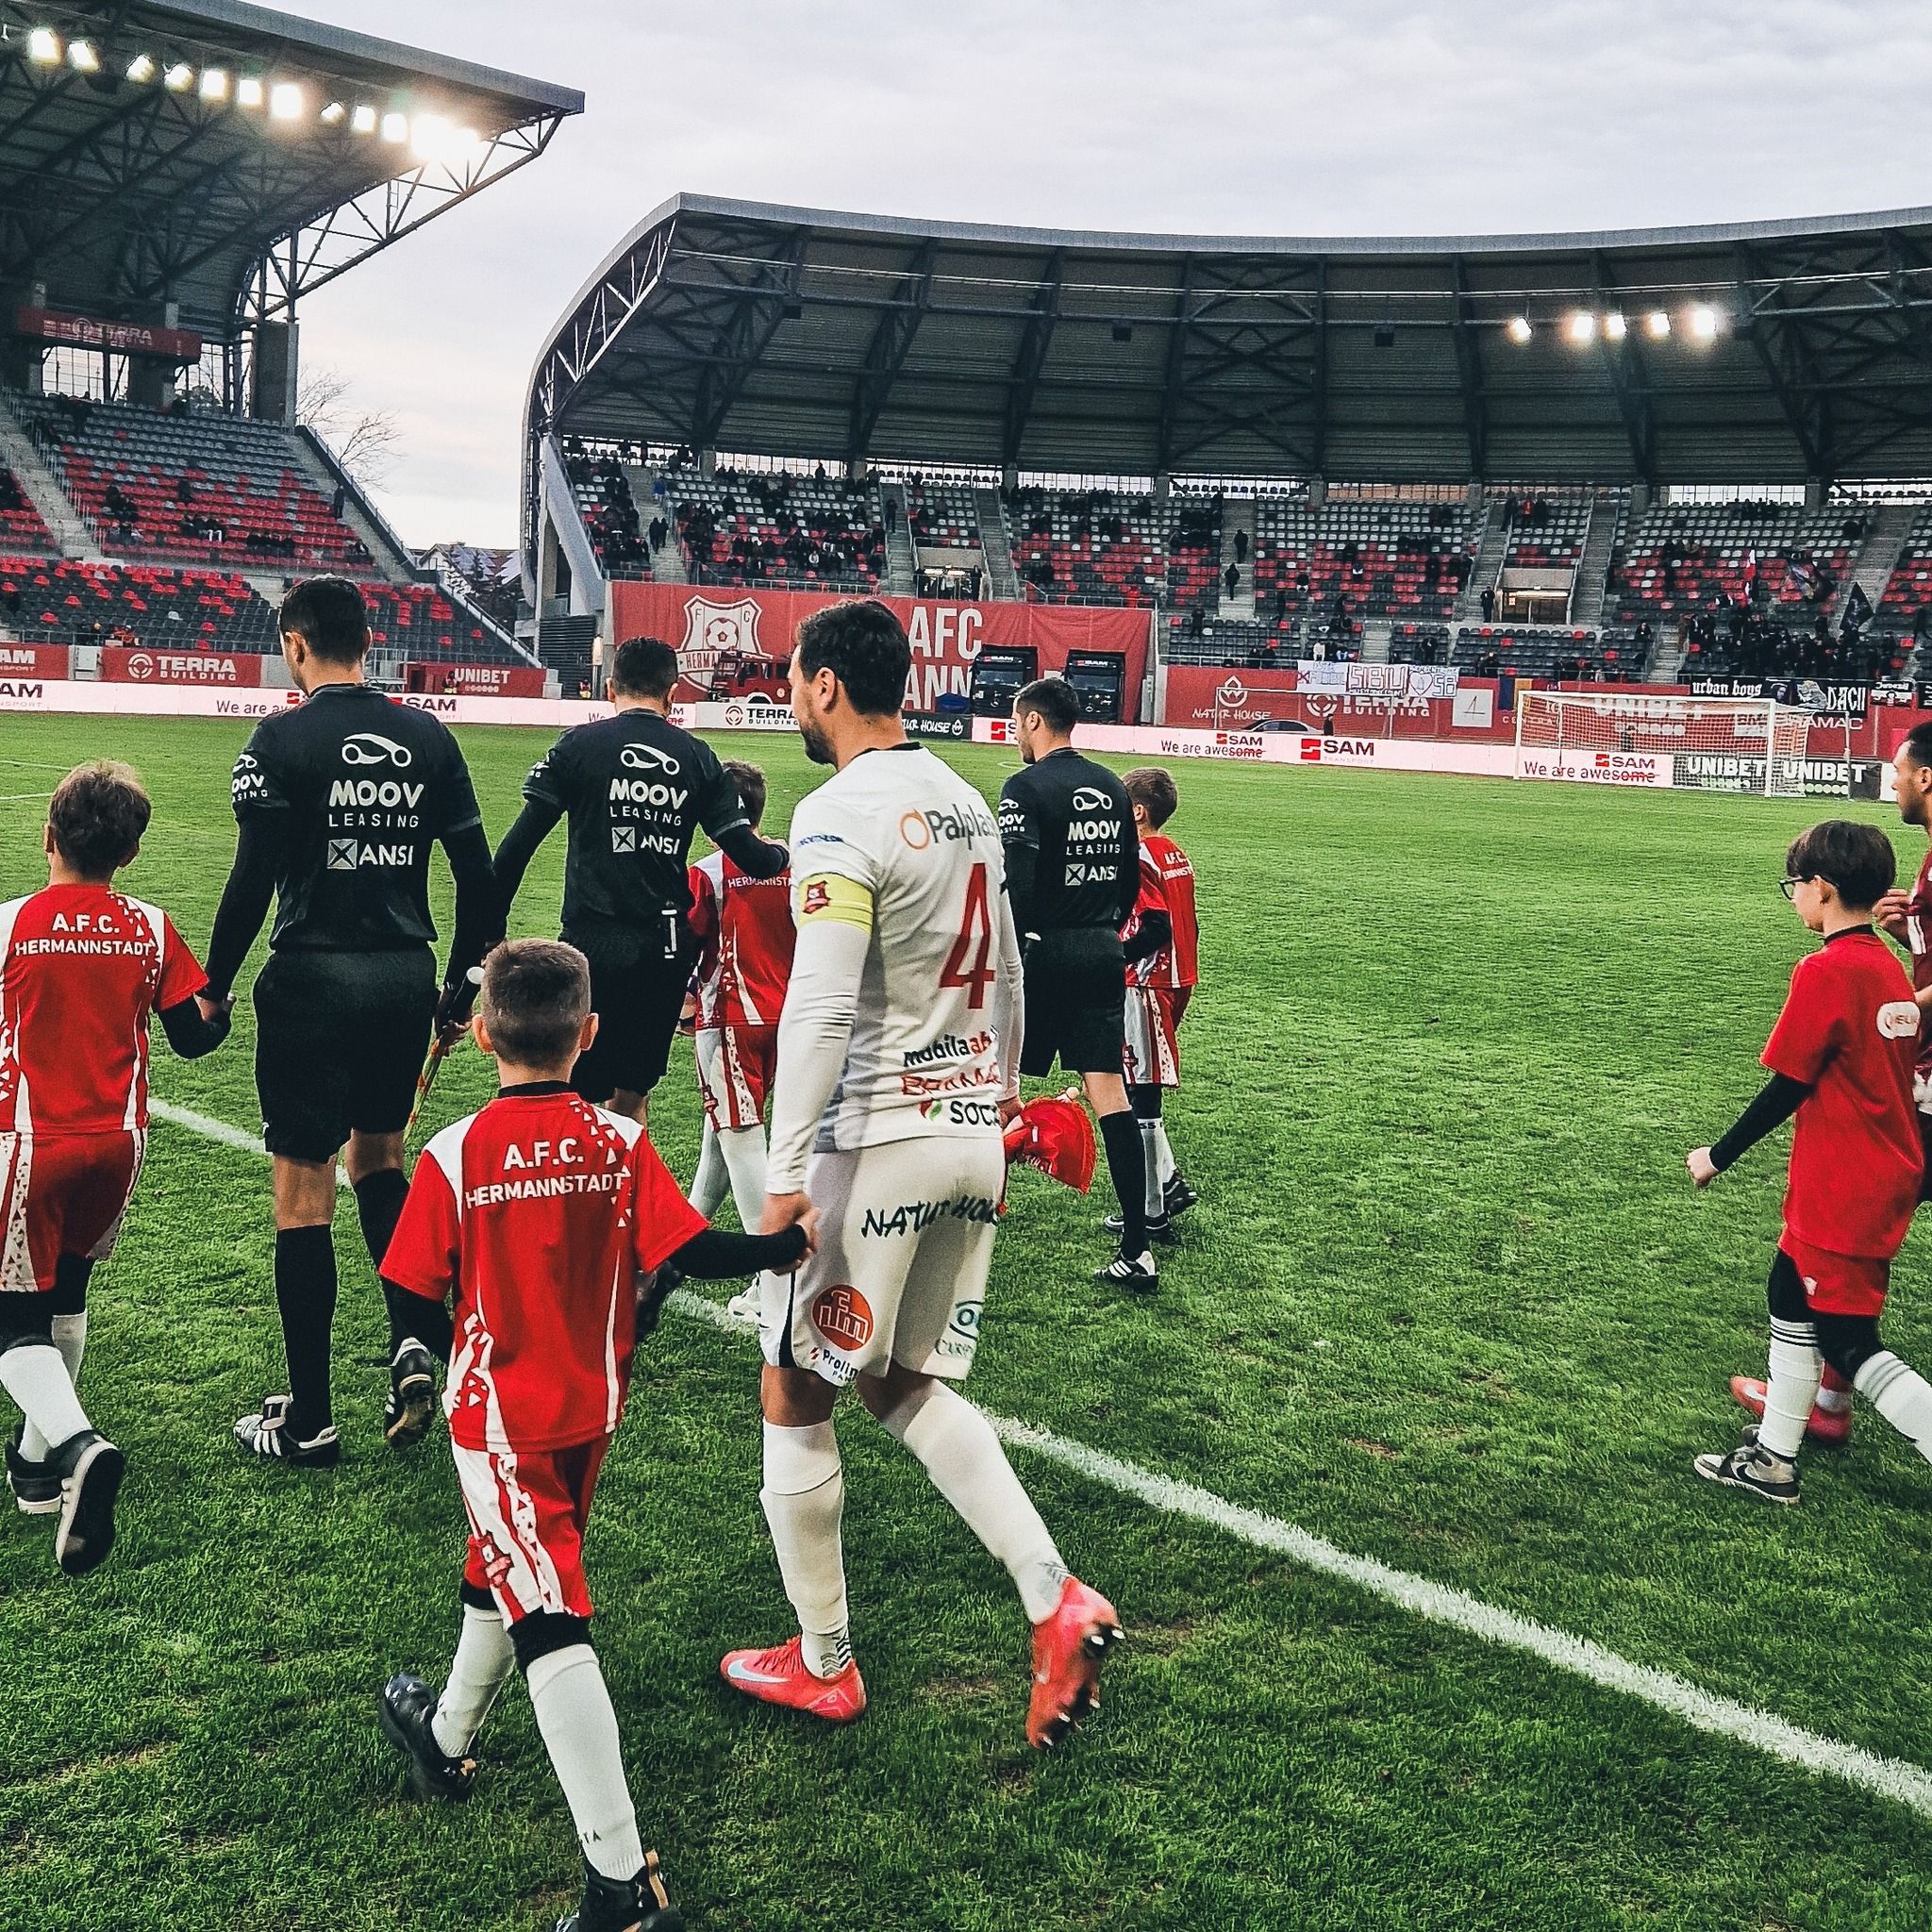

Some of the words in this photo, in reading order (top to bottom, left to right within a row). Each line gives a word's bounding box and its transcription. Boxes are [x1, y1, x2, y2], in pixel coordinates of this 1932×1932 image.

[694, 608, 702, 621] F
[908, 607, 983, 660] AFC
[157, 656, 237, 674] TERRA
[159, 670, 237, 681] BUILDING
[455, 668, 510, 684] UNIBET
[1350, 665, 1407, 690] SIBIU
[1433, 674, 1457, 697] SB
[1692, 678, 1729, 695] urban
[1732, 680, 1762, 698] boys
[216, 700, 240, 714] We
[243, 704, 267, 714] are
[406, 697, 457, 711] SAM
[1825, 686, 1866, 711] DACII
[1233, 709, 1272, 721] HOUSE
[1343, 708, 1430, 717] BUILDING
[921, 719, 951, 734] HOUSE
[1161, 740, 1179, 753] We
[1182, 743, 1201, 754] are
[1205, 746, 1264, 758] awesome
[1229, 736, 1263, 746] SAM
[1324, 740, 1374, 756] SAM
[1324, 756, 1374, 765] TRANSPORT
[1611, 756, 1656, 769] SAM
[1688, 757, 1767, 777] UNIBET
[1524, 760, 1547, 775] We
[1552, 766, 1575, 778] are
[1580, 768, 1657, 783] awesome
[1783, 760, 1867, 783] UNIBET
[329, 779, 425, 808] MOOV
[609, 778, 688, 810] MOOV
[328, 813, 420, 828] LEASING
[609, 806, 682, 826] LEASING
[1067, 820, 1122, 841] MOOV
[52, 912, 121, 934] A.F.C.
[938, 862, 996, 1010] 4
[14, 939, 153, 957] HERMANNSTADT
[503, 1138, 584, 1171] A.F.C.
[465, 1172, 625, 1209] HERMANNSTADT
